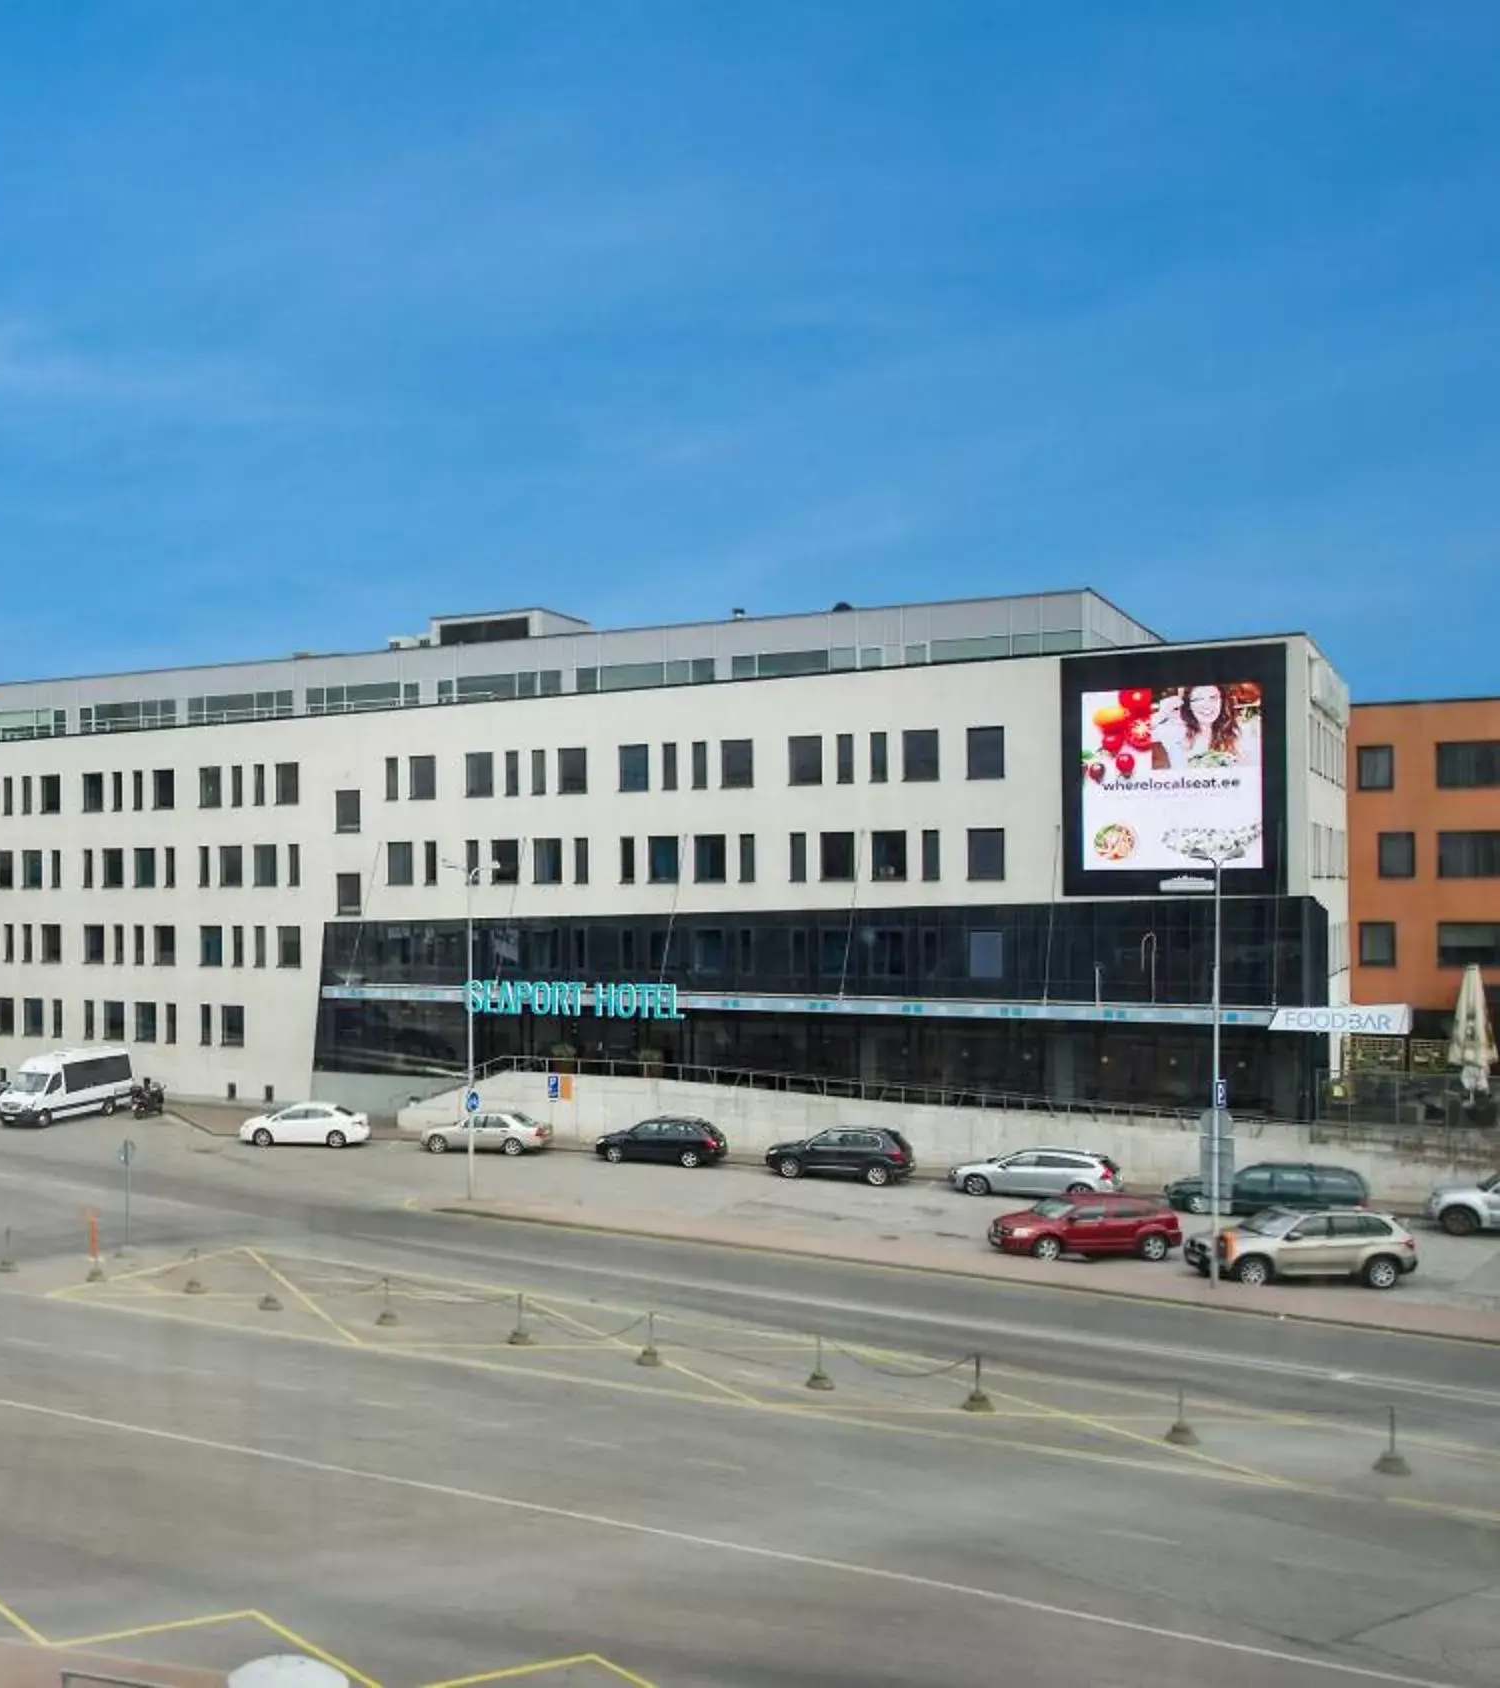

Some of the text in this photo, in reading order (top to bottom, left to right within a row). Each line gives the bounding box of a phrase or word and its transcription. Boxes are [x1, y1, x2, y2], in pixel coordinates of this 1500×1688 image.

[1102, 777, 1240, 791] wherelocalseat.ee
[463, 979, 686, 1019] SEAPORT HOTEL
